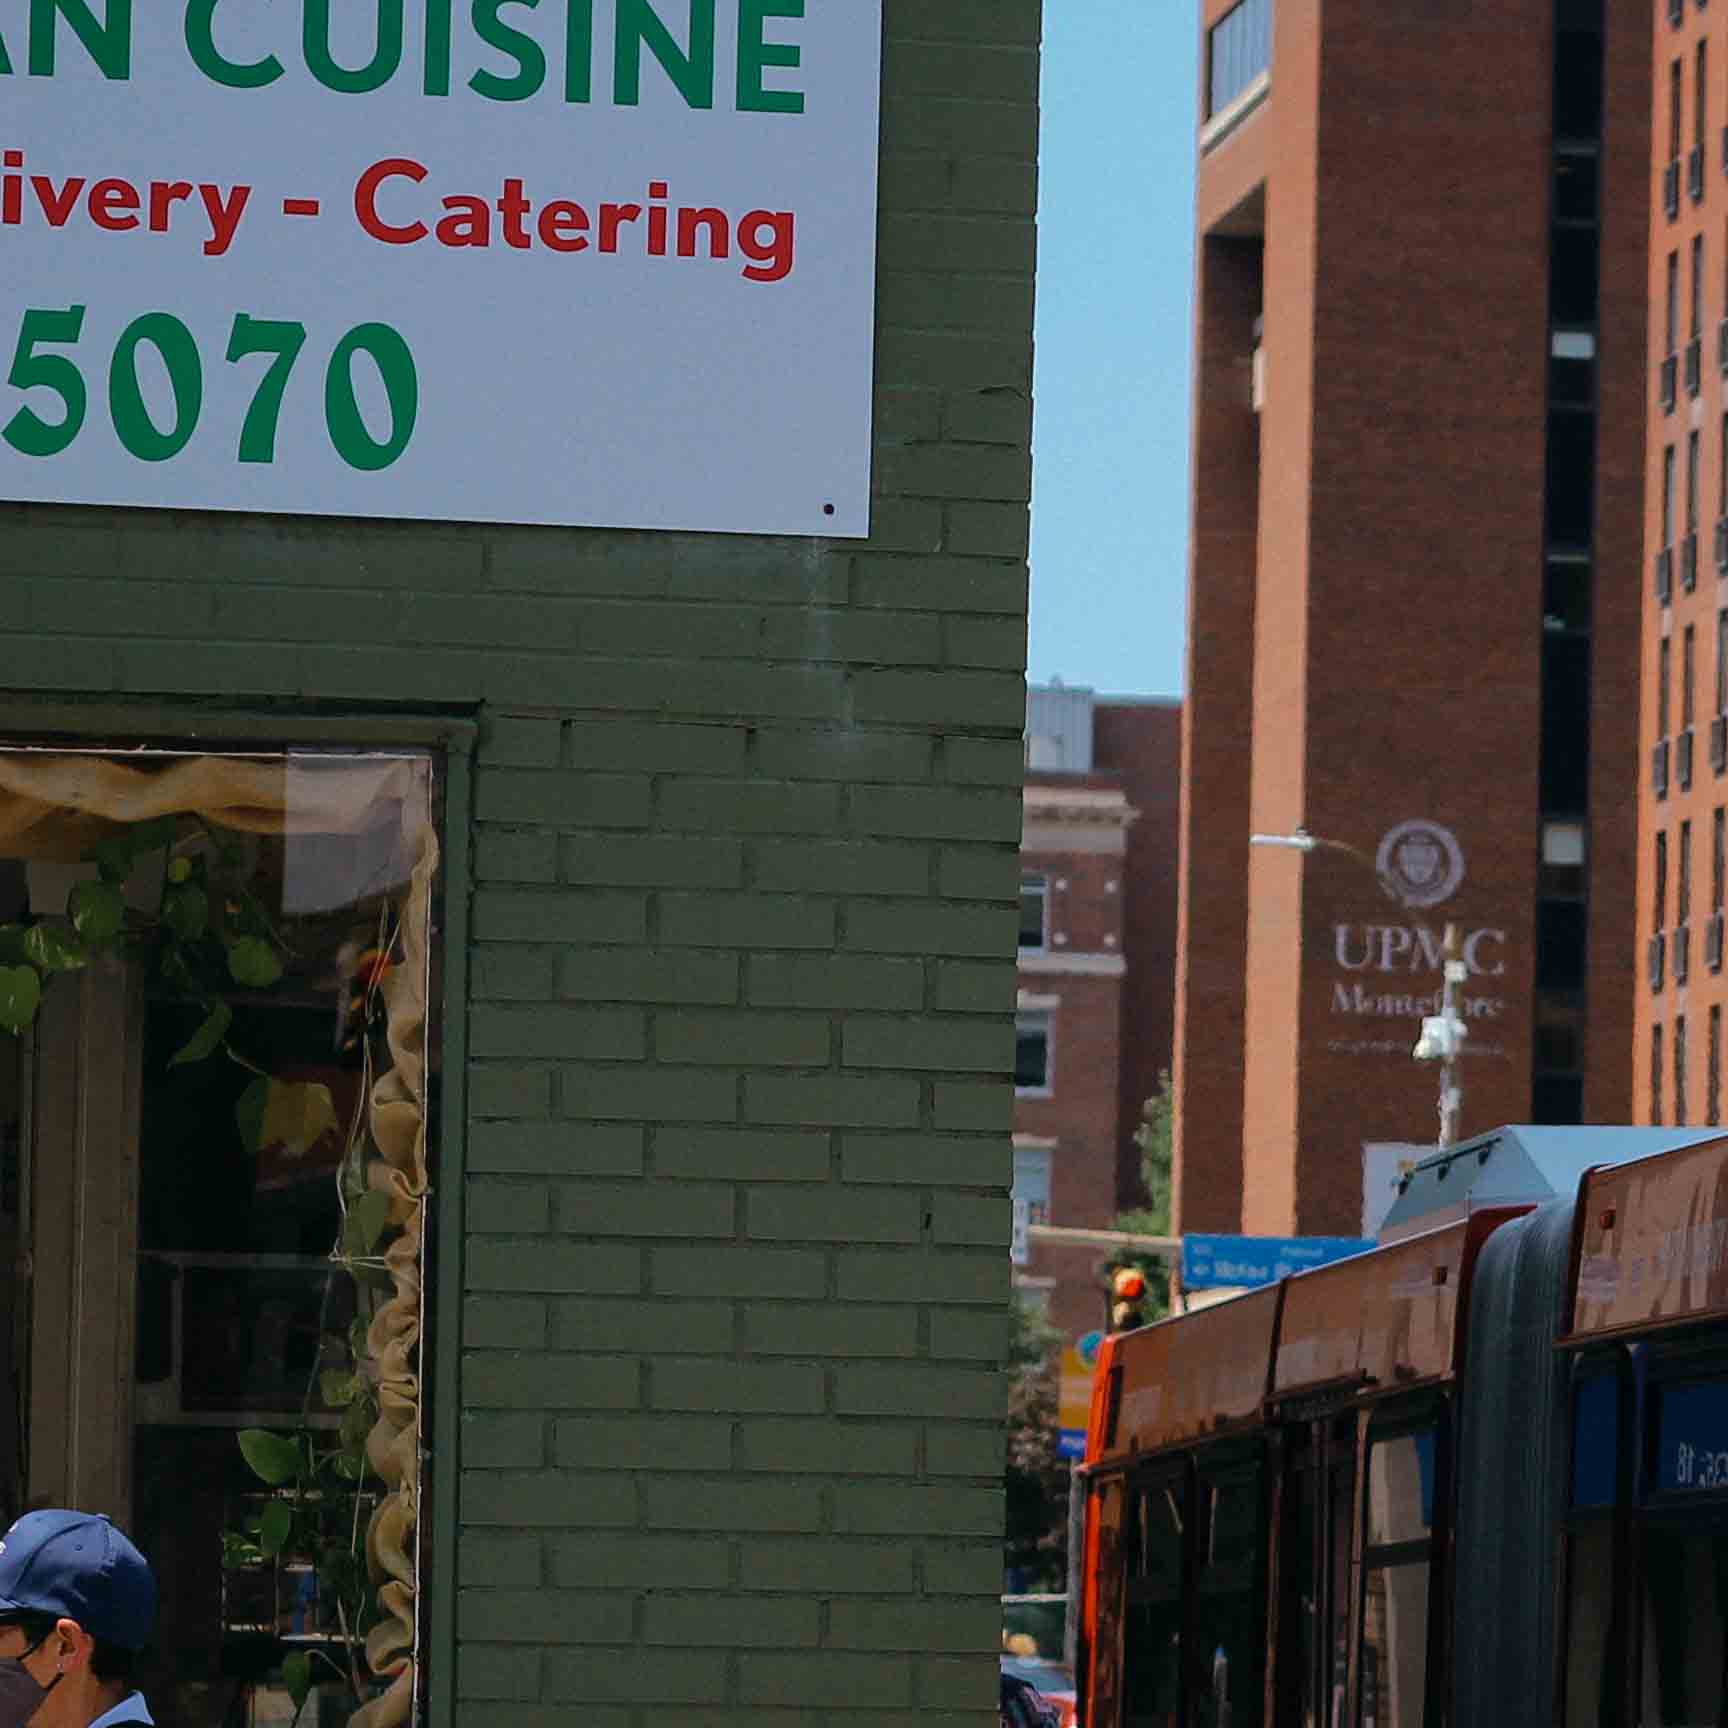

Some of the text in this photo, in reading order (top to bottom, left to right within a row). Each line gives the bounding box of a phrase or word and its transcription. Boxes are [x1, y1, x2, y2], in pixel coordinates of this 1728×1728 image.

[0, 0, 807, 114] N CUISINE
[354, 158, 795, 282] Catering
[0, 303, 420, 473] 5070
[1335, 923, 1505, 976] UPMC
